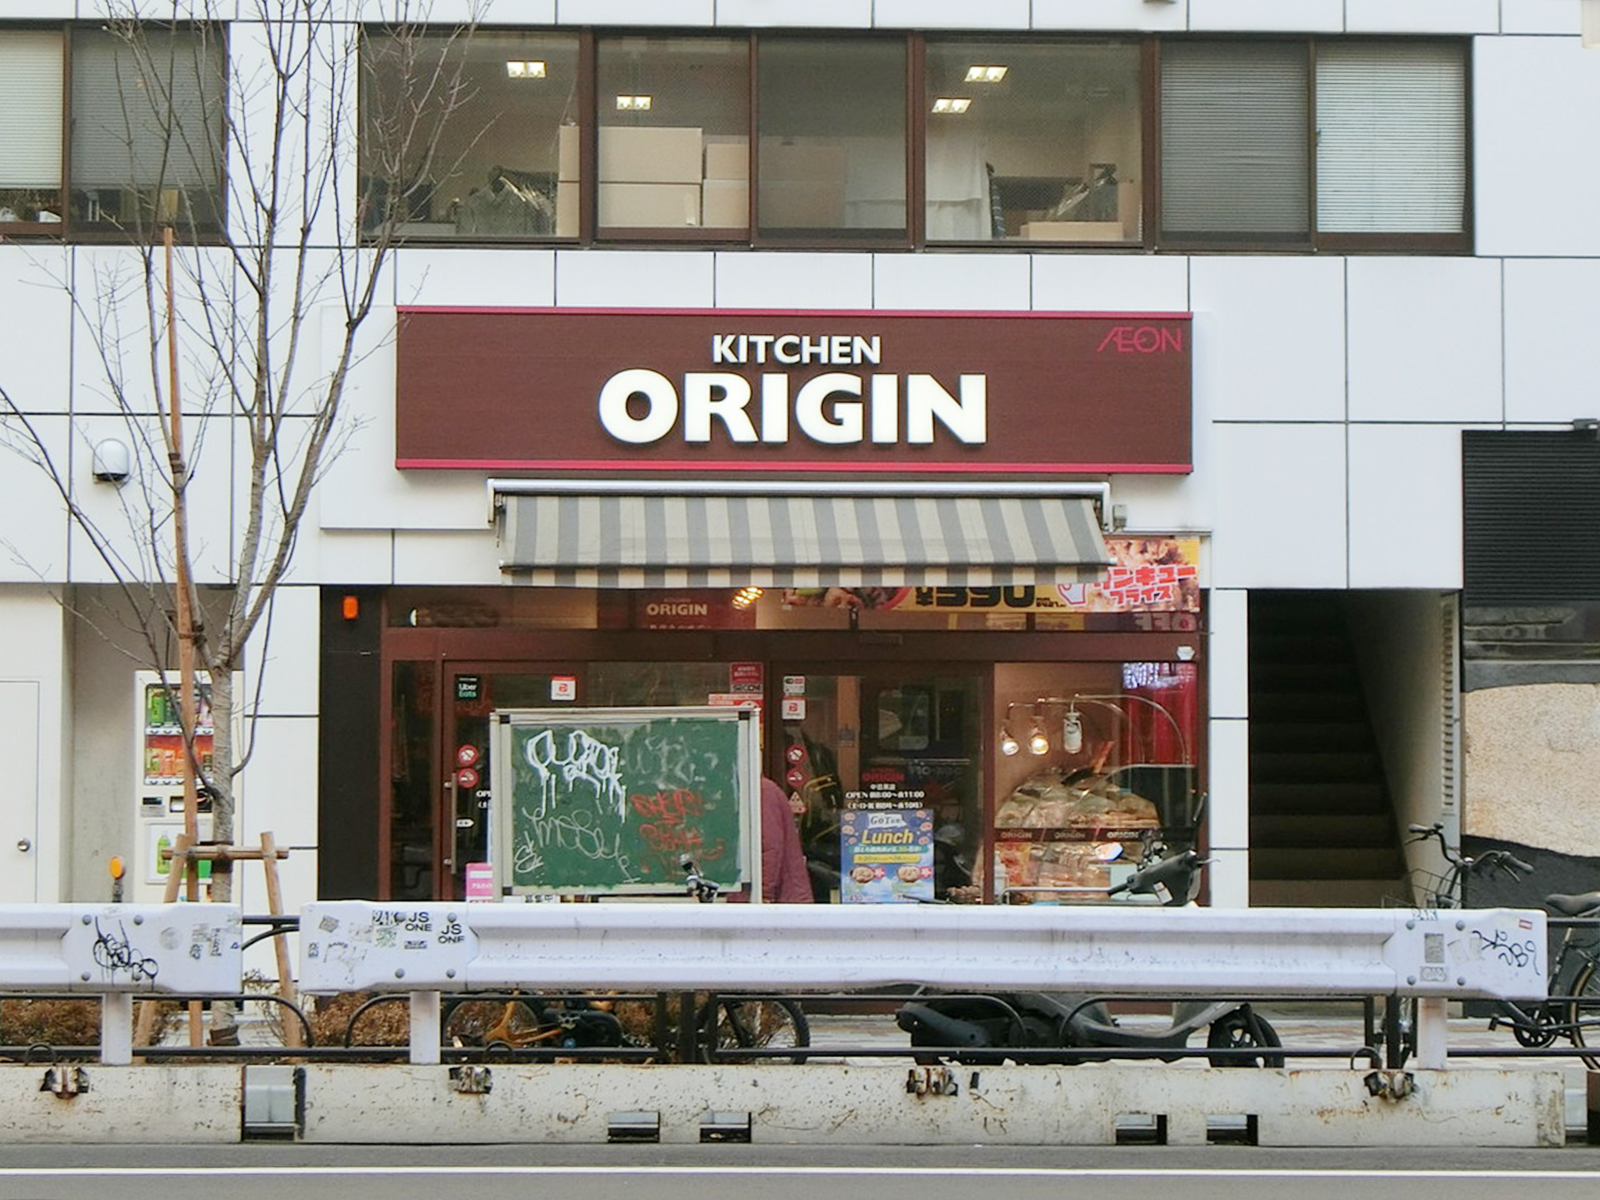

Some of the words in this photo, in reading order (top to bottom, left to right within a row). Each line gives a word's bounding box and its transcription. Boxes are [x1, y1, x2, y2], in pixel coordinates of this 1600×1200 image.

[712, 334, 882, 365] KITCHEN
[599, 368, 988, 444] ORIGIN
[646, 603, 708, 616] ORIGIN
[458, 690, 477, 698] Eats
[845, 791, 869, 799] OPEN
[861, 828, 914, 845] Lunch
[408, 911, 430, 923] JS
[404, 923, 433, 932] ONE
[441, 923, 462, 935] JS
